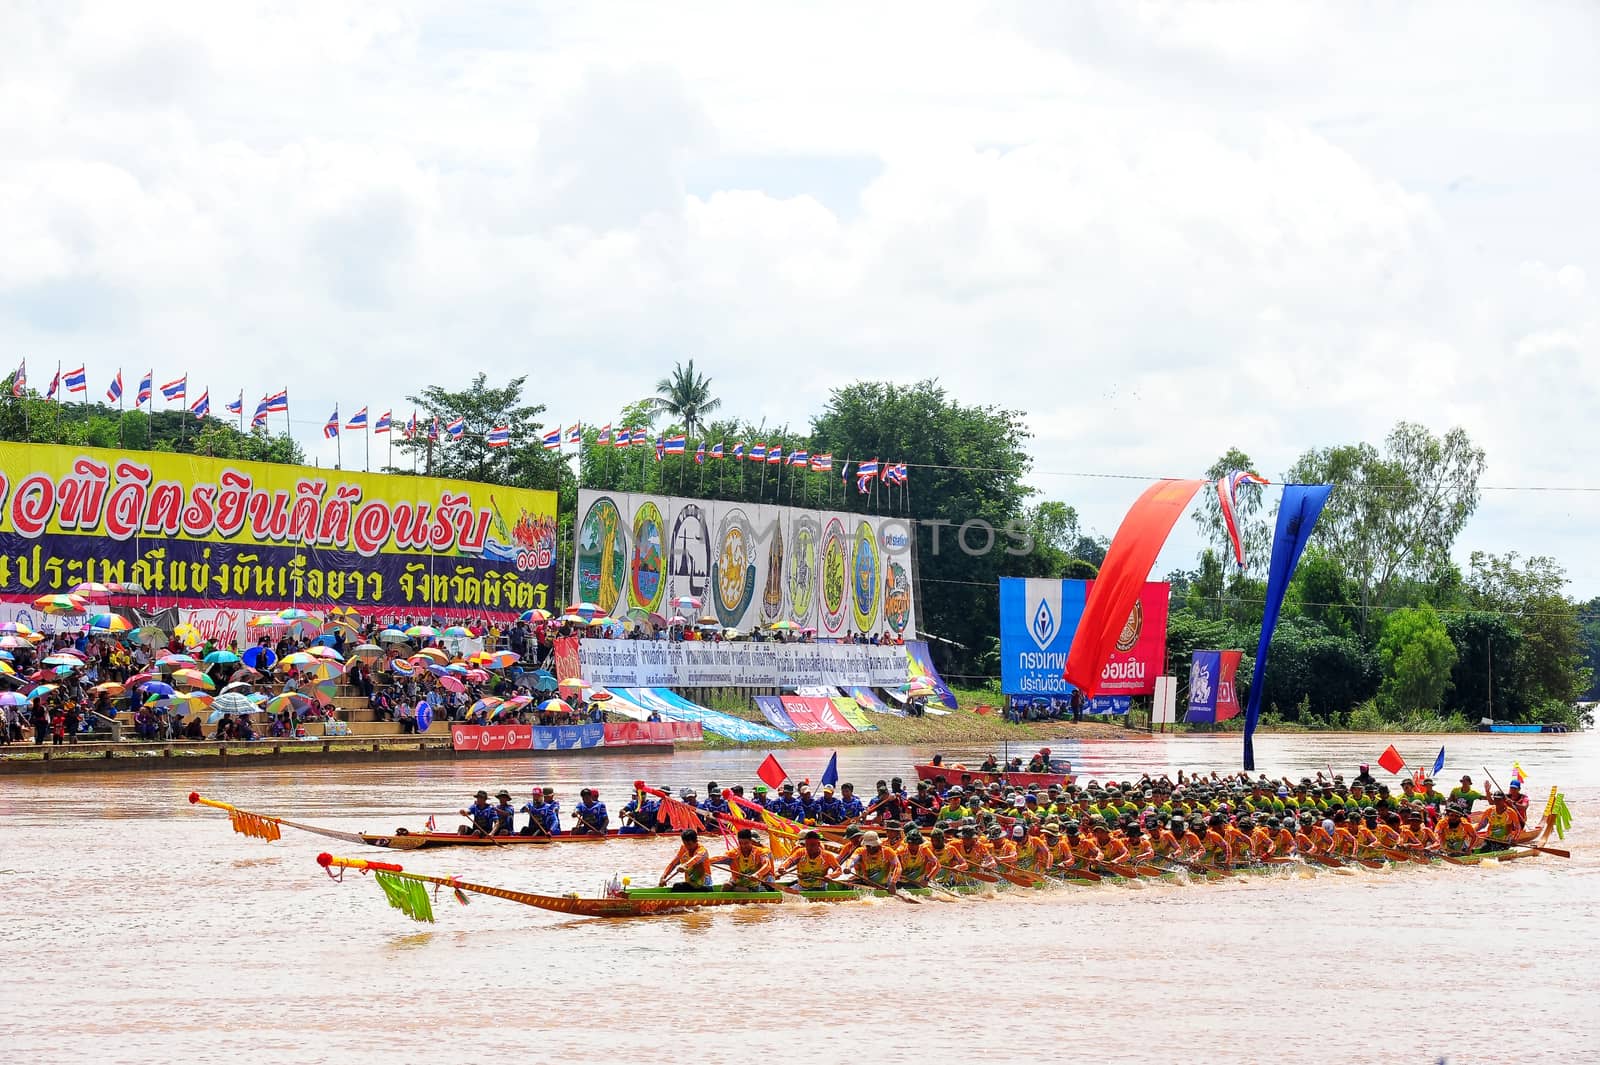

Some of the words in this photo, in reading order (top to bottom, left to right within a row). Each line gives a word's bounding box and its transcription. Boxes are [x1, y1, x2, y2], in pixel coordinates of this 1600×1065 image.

[0, 455, 492, 557] วพิจิตรยินดีต้อนรับ
[399, 562, 549, 609] จังหวัดพิจิตร
[1019, 652, 1066, 676] กรุงเทพ
[1020, 673, 1066, 691] ประกันชีวิต
